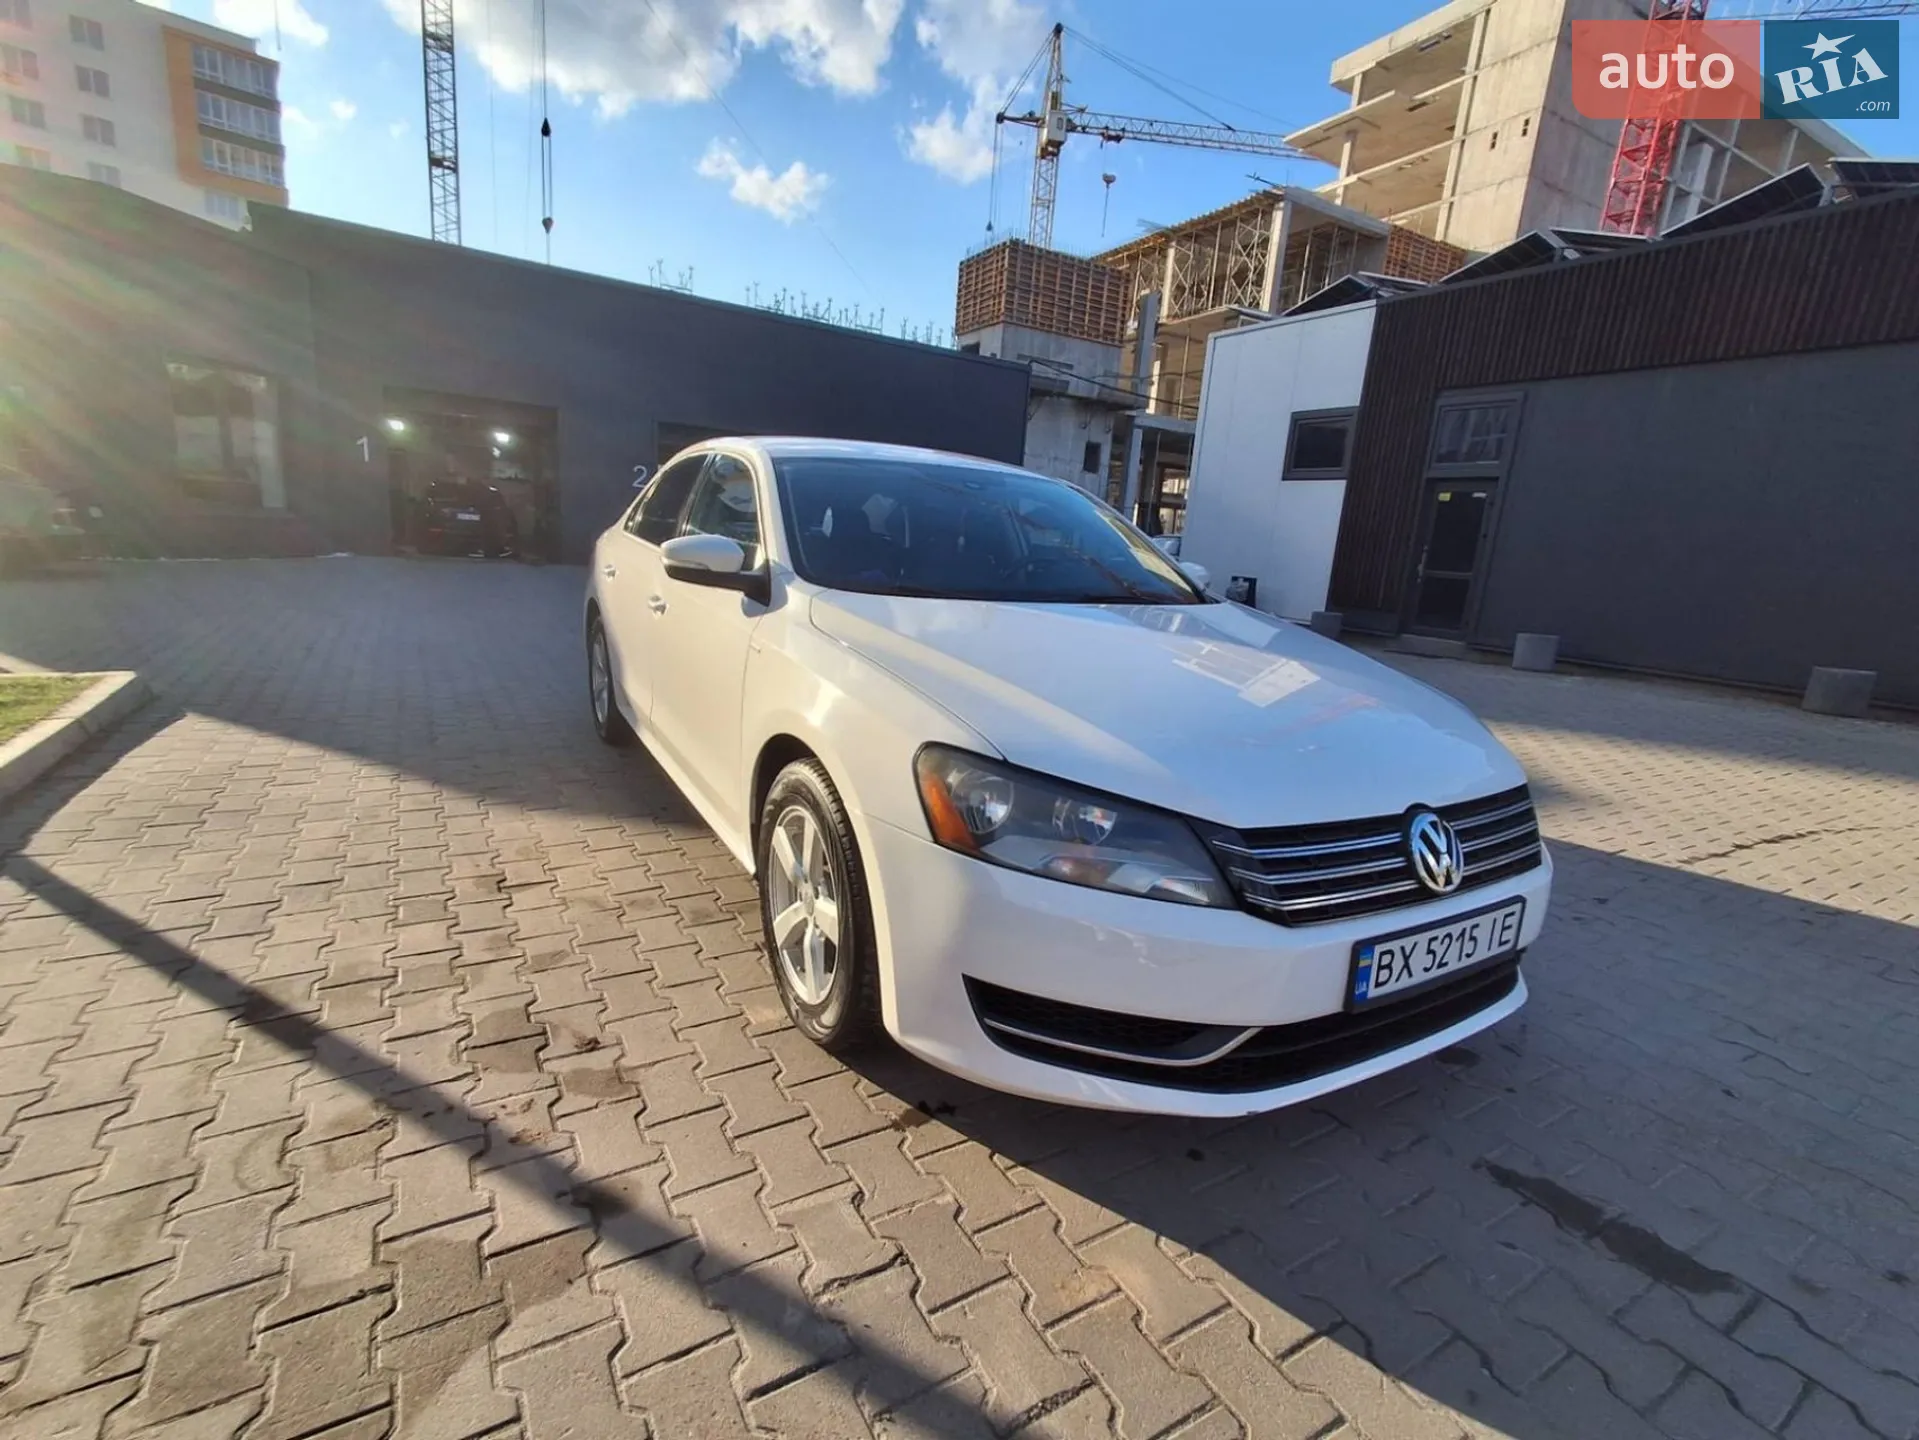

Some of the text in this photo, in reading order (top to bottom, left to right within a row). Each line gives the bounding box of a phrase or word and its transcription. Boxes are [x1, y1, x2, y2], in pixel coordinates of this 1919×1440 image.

[356, 435, 369, 462] 1
[631, 464, 648, 488] 2
[1374, 911, 1516, 989] BX 5215 IE
